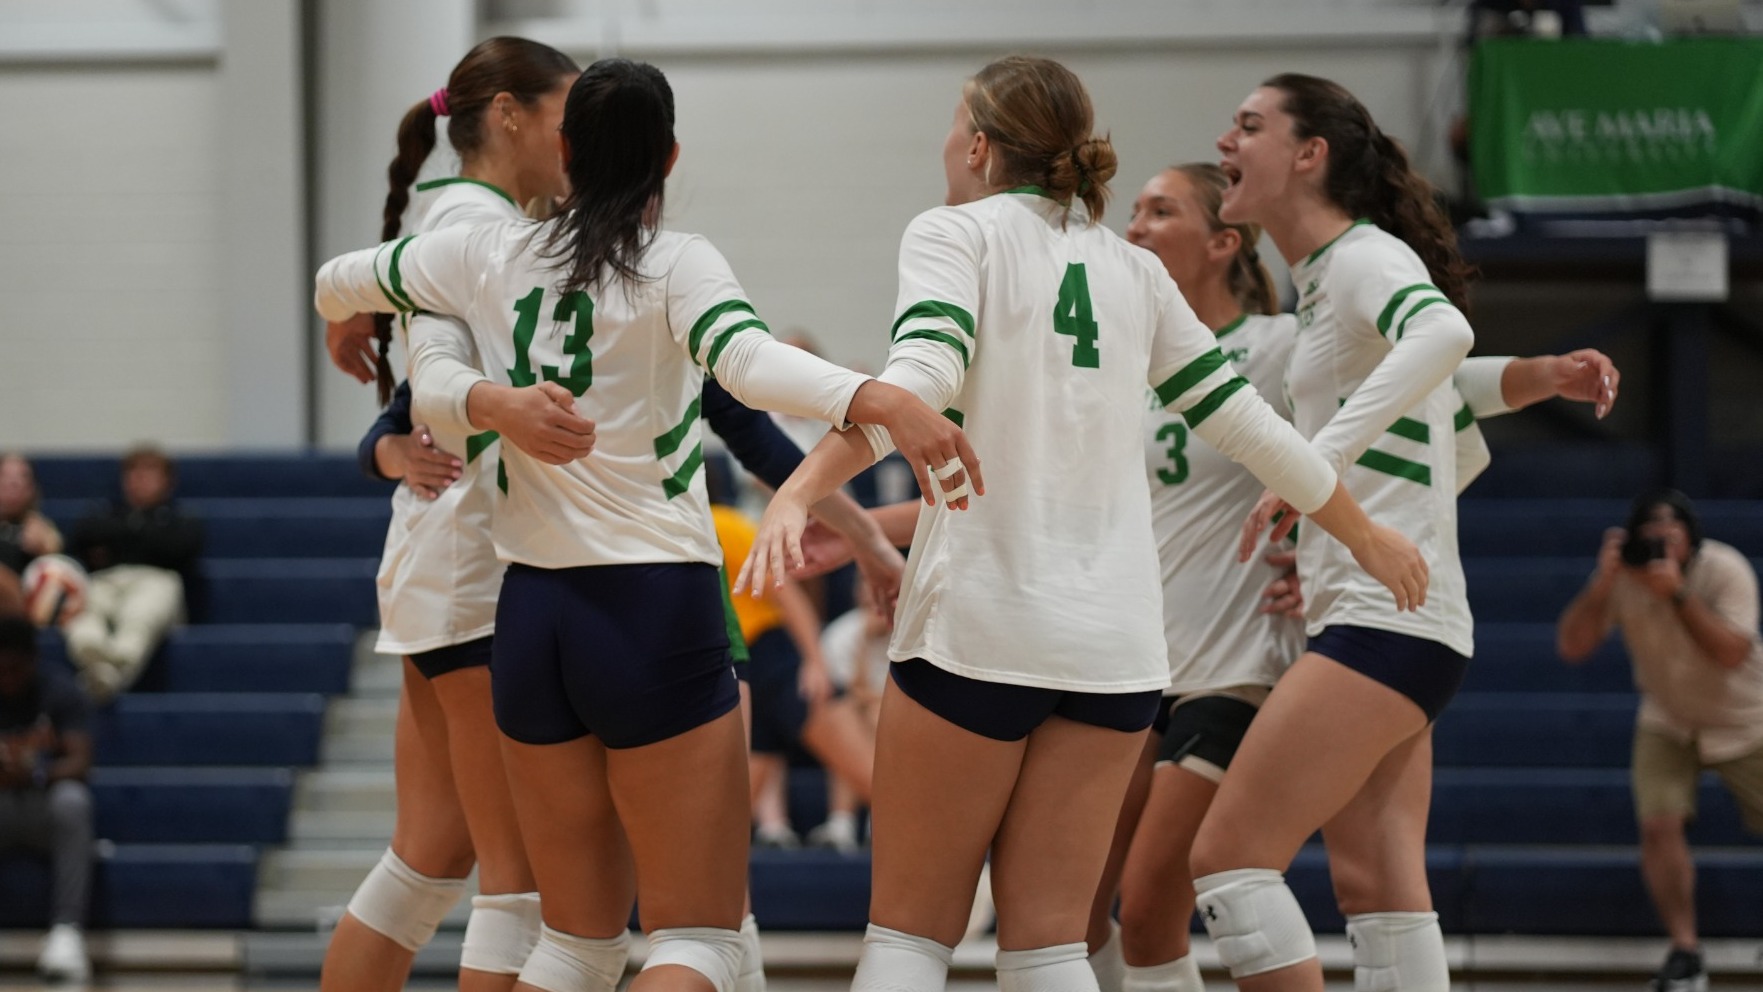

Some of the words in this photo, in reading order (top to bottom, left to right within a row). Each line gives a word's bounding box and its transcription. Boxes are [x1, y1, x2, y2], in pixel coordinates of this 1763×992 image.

[1523, 108, 1586, 141] AVE
[1595, 107, 1716, 142] MARIA
[506, 286, 594, 397] 13
[1053, 262, 1100, 368] 4
[1156, 421, 1189, 484] 3
